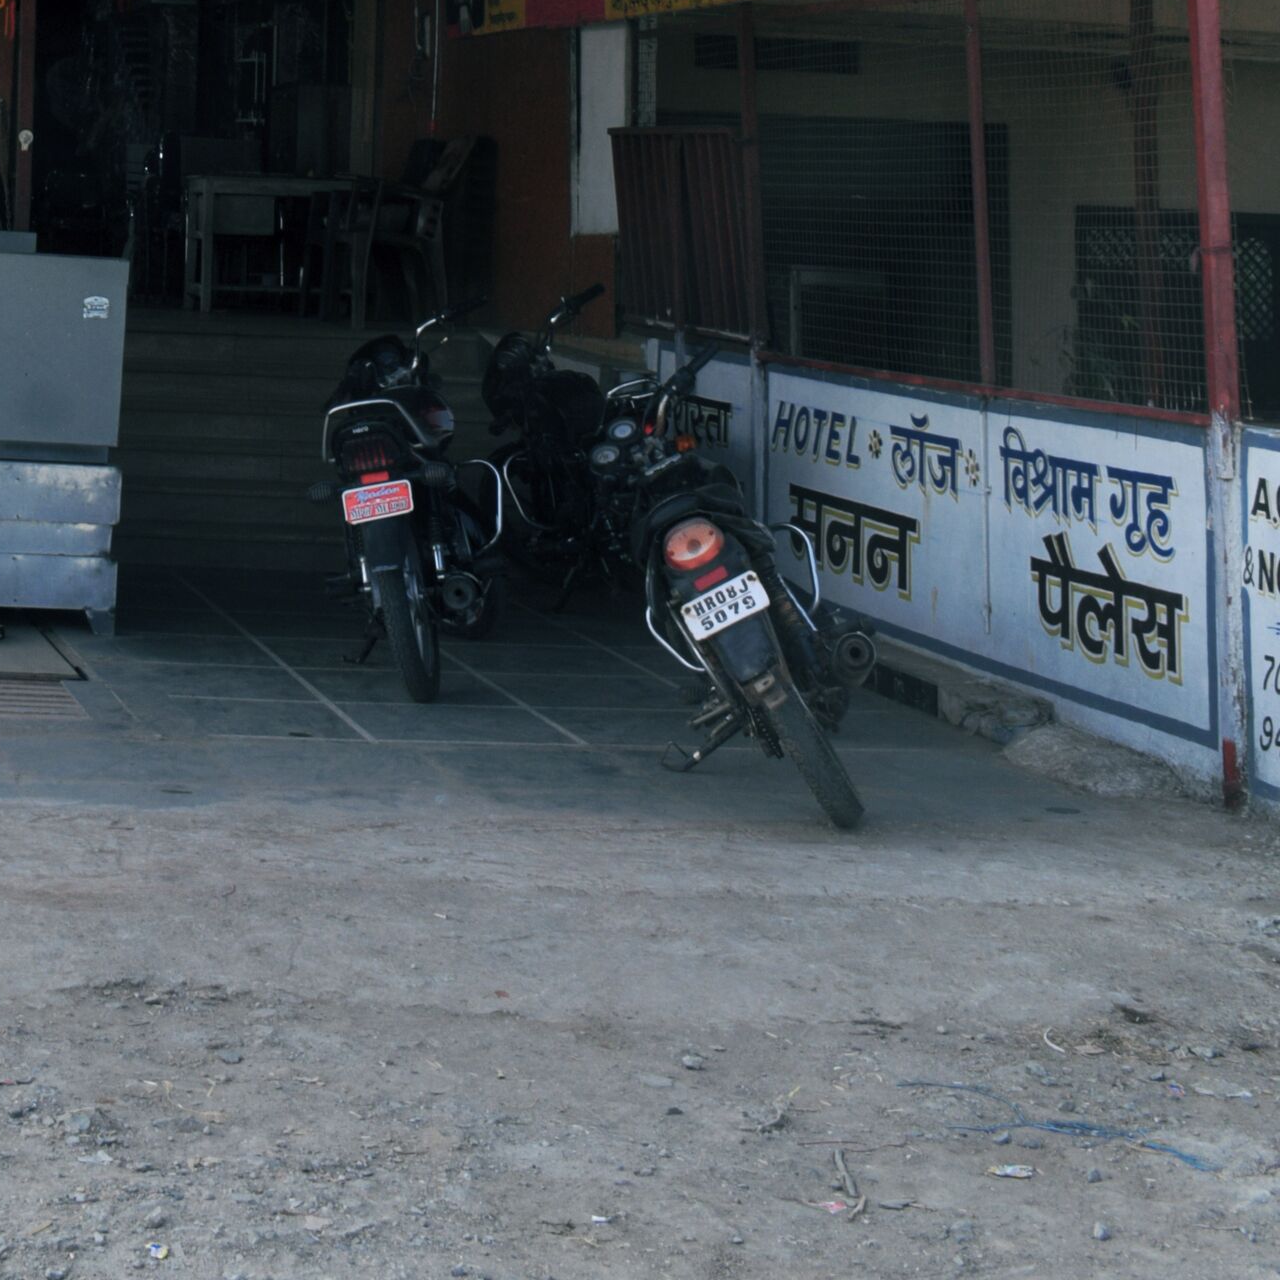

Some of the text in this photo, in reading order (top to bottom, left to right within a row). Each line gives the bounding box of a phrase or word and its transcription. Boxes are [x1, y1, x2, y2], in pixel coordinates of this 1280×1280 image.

[772, 400, 861, 468] HOTEL
[889, 413, 961, 497] लॉज
[1000, 426, 1176, 558] विश्राम गृह
[700, 595, 756, 631] 5079
[789, 483, 1187, 678] मनन पैलेस
